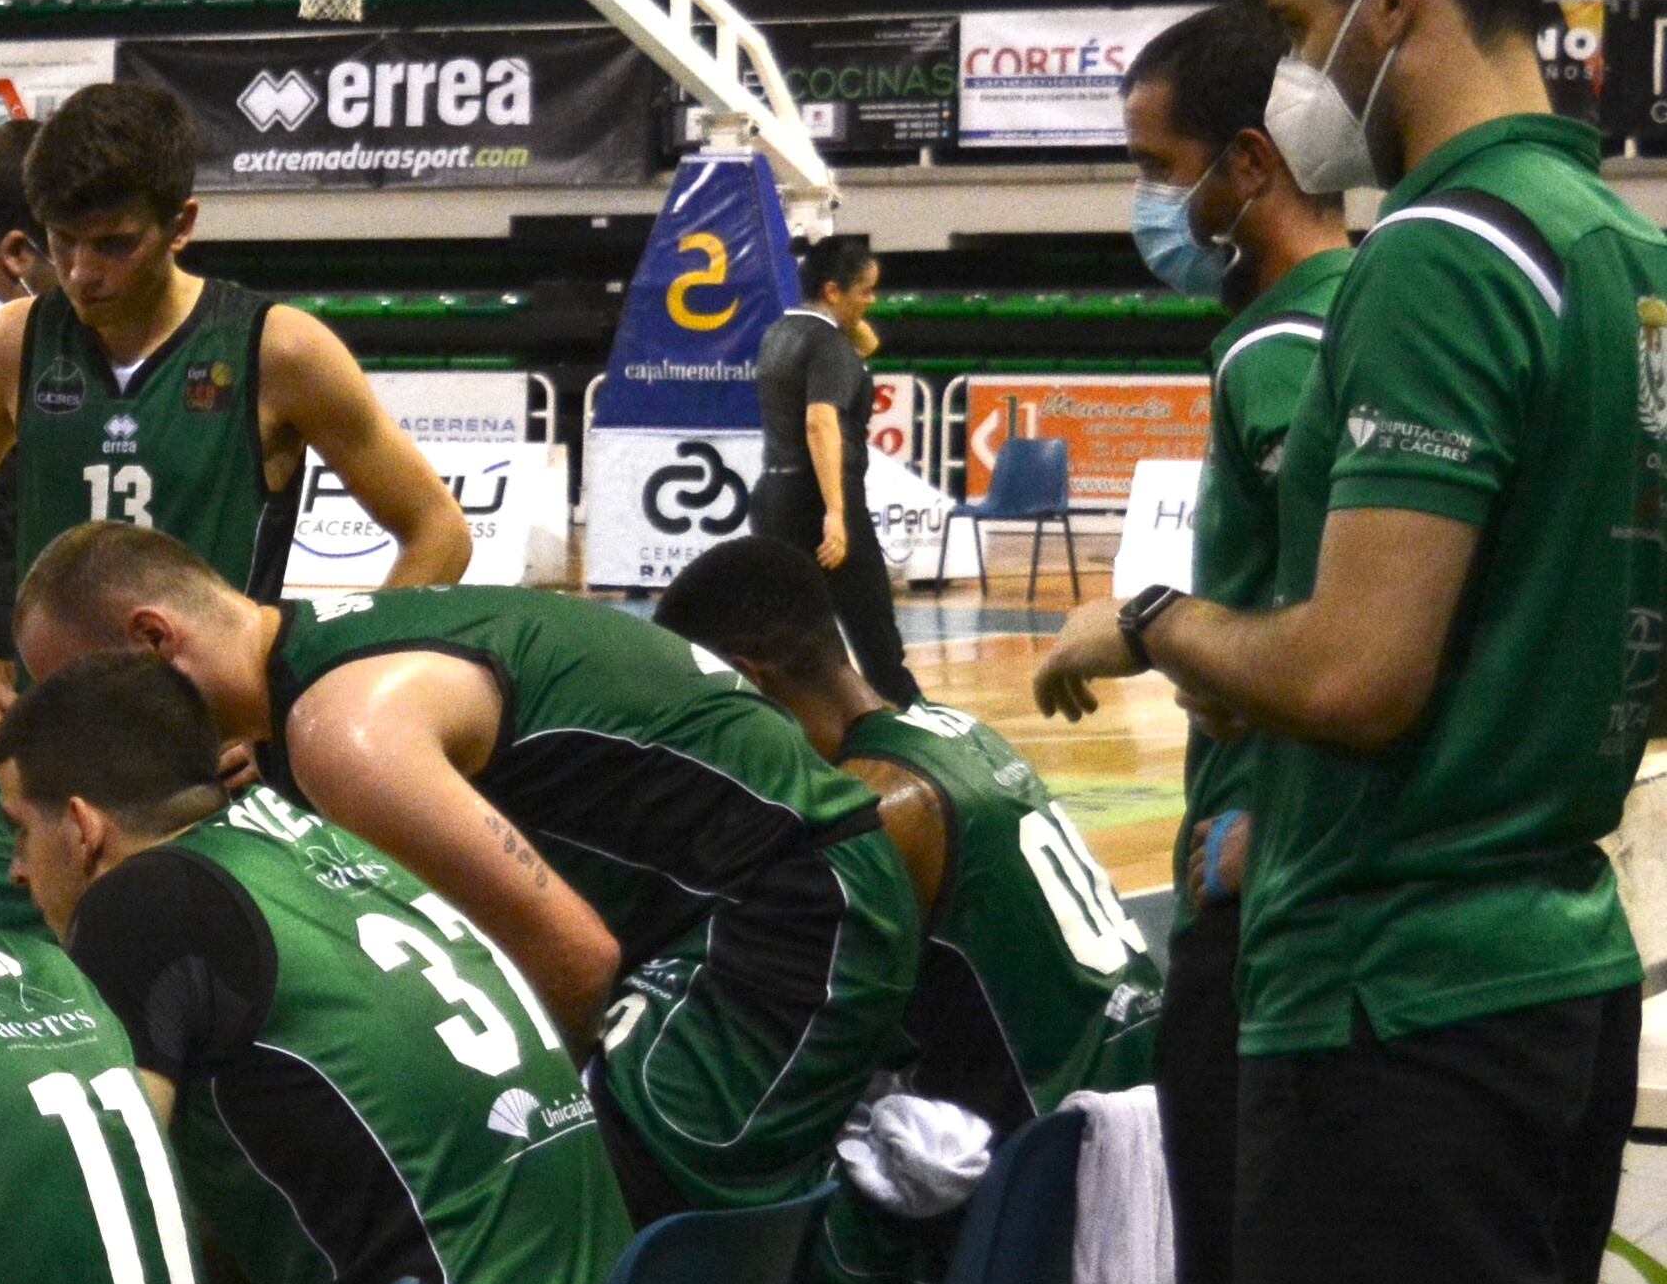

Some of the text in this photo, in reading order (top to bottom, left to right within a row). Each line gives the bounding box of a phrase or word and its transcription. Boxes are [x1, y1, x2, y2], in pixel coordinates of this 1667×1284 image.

[965, 38, 1125, 76] CORTÉS
[327, 57, 531, 128] errea
[233, 141, 529, 177] extremadurasport.com
[102, 440, 137, 453] errea
[83, 464, 153, 529] 13
